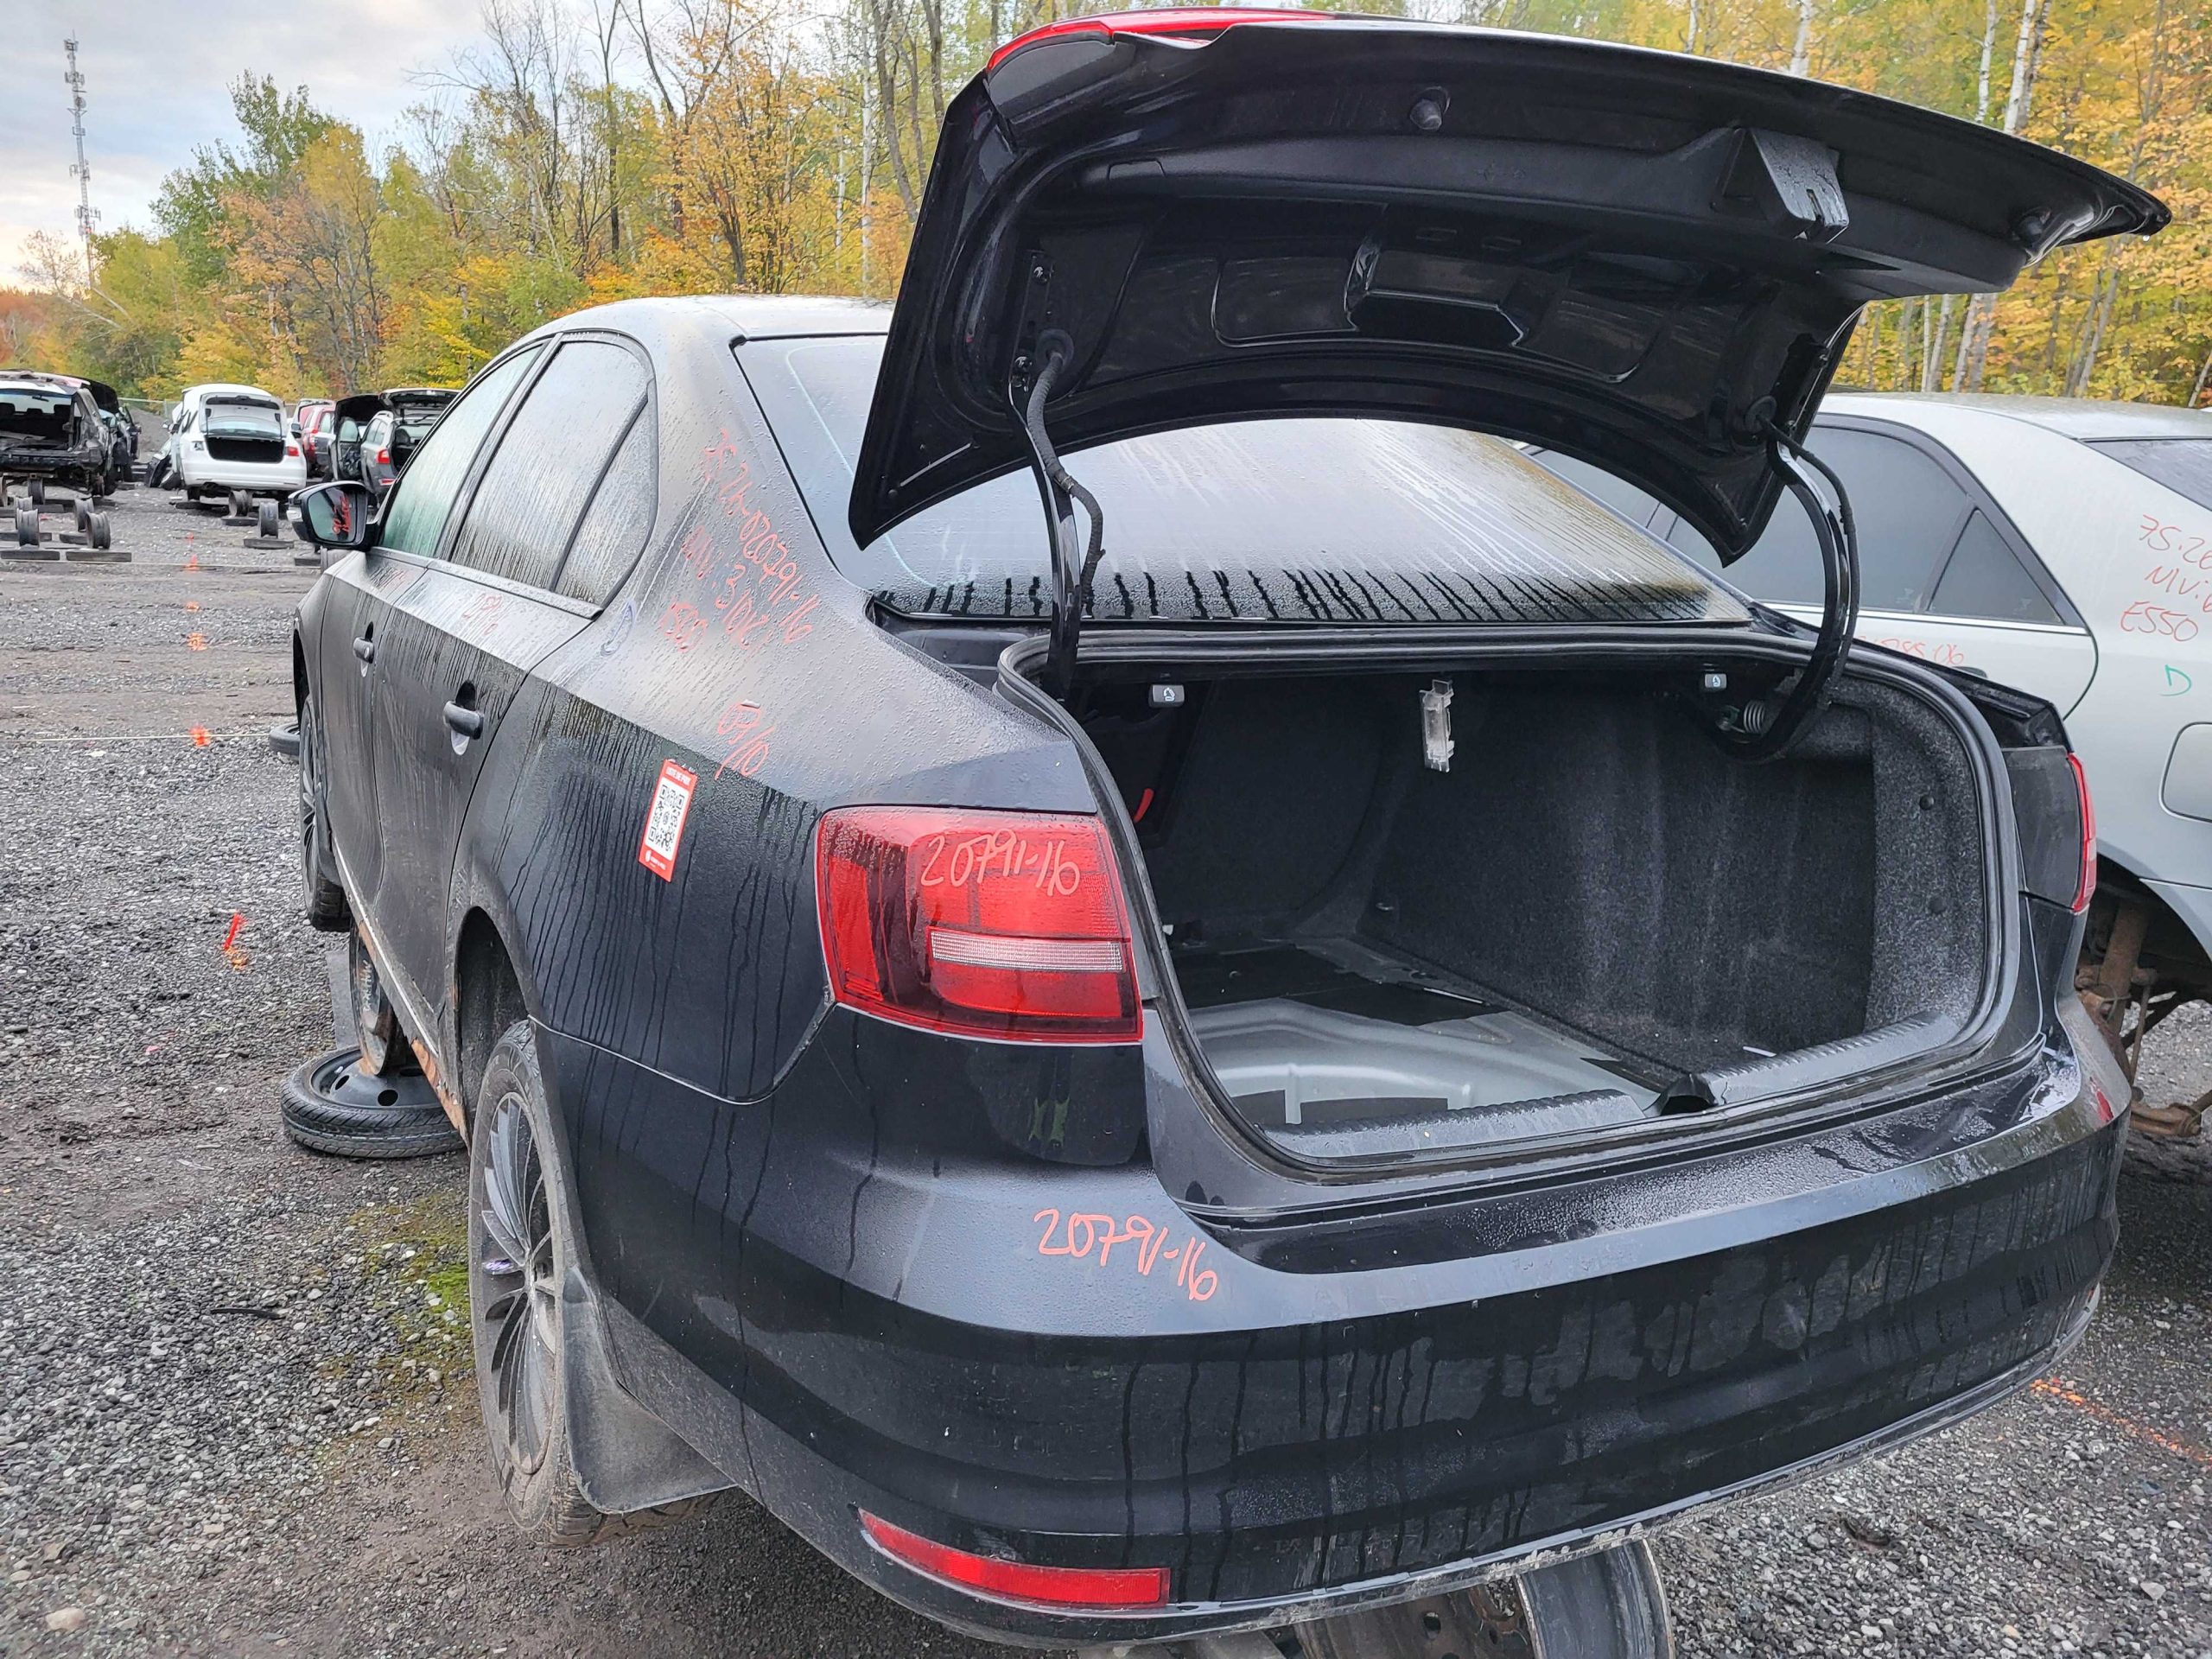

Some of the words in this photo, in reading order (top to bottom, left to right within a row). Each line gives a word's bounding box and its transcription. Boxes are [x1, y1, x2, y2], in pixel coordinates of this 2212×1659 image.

[2159, 664, 2192, 696] D
[920, 828, 1081, 897] 20791-16
[1033, 1208, 1218, 1301] 20791-16
